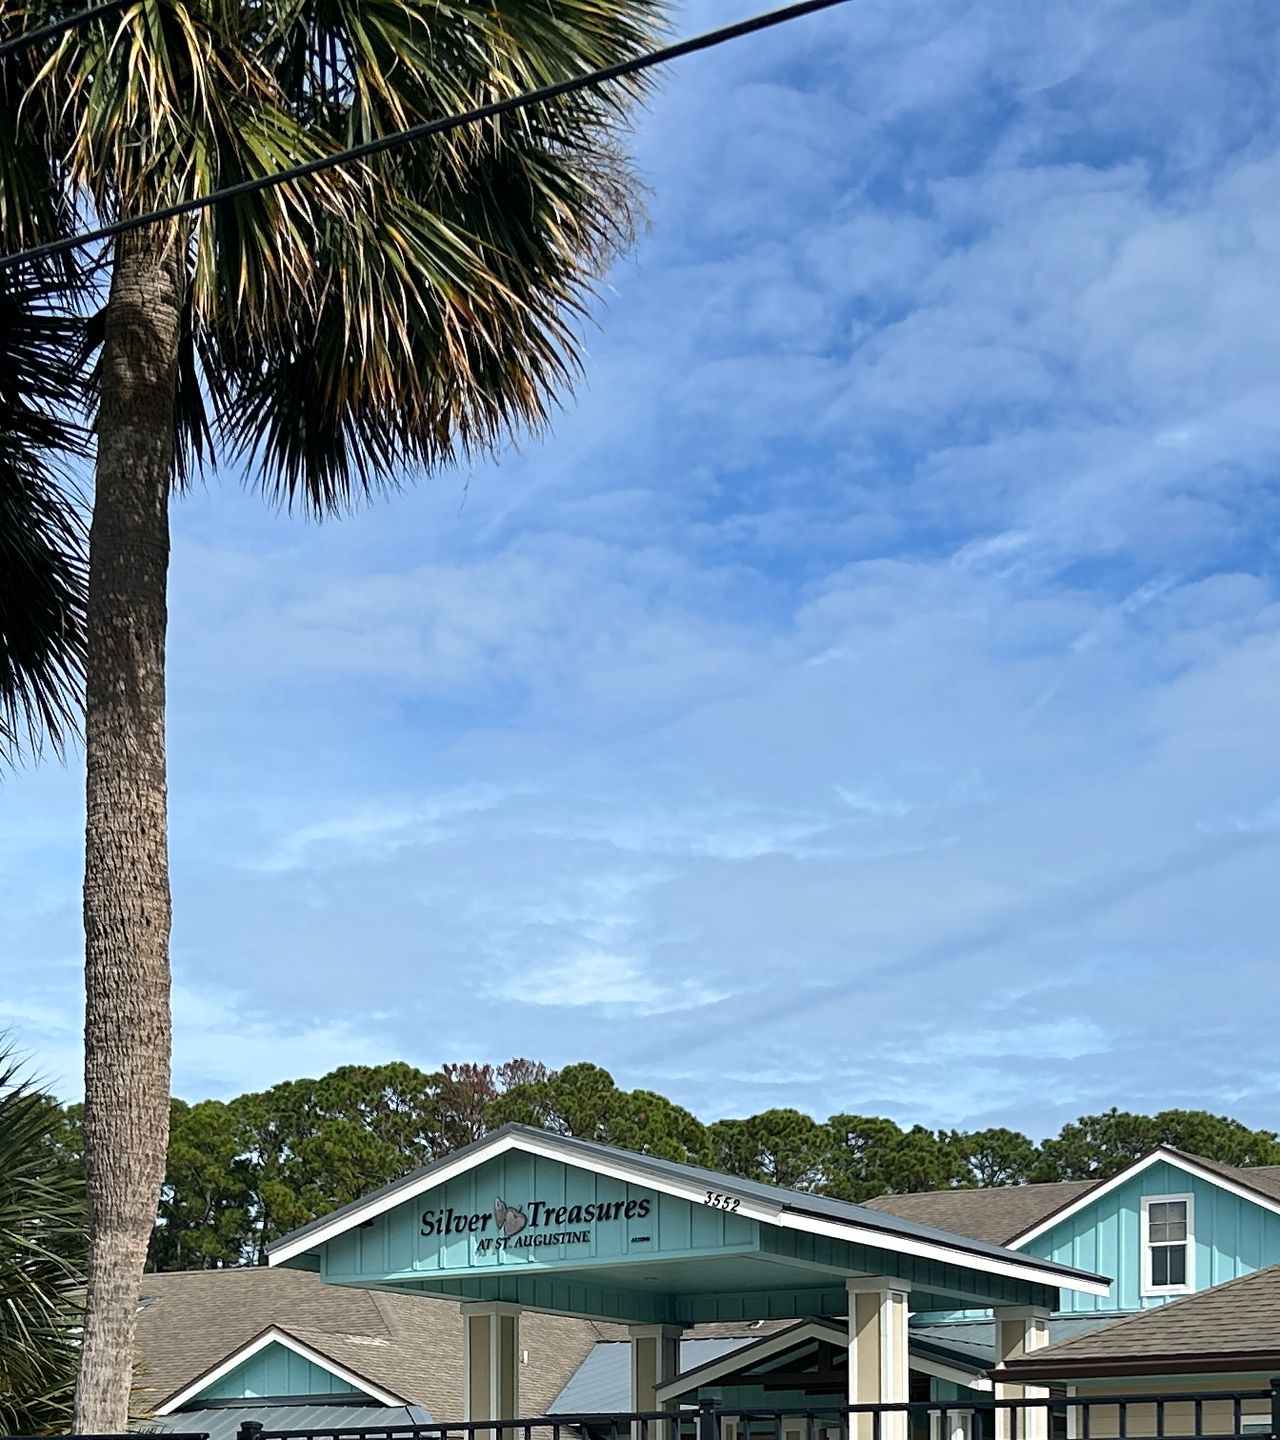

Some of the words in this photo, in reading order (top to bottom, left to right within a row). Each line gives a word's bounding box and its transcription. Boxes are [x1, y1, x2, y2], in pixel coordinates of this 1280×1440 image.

[704, 1191, 741, 1213] 3552
[420, 1208, 492, 1237] Silver
[527, 1198, 651, 1228] Treasures
[476, 1237, 494, 1251] AT
[514, 1230, 591, 1248] AUGUSTINE
